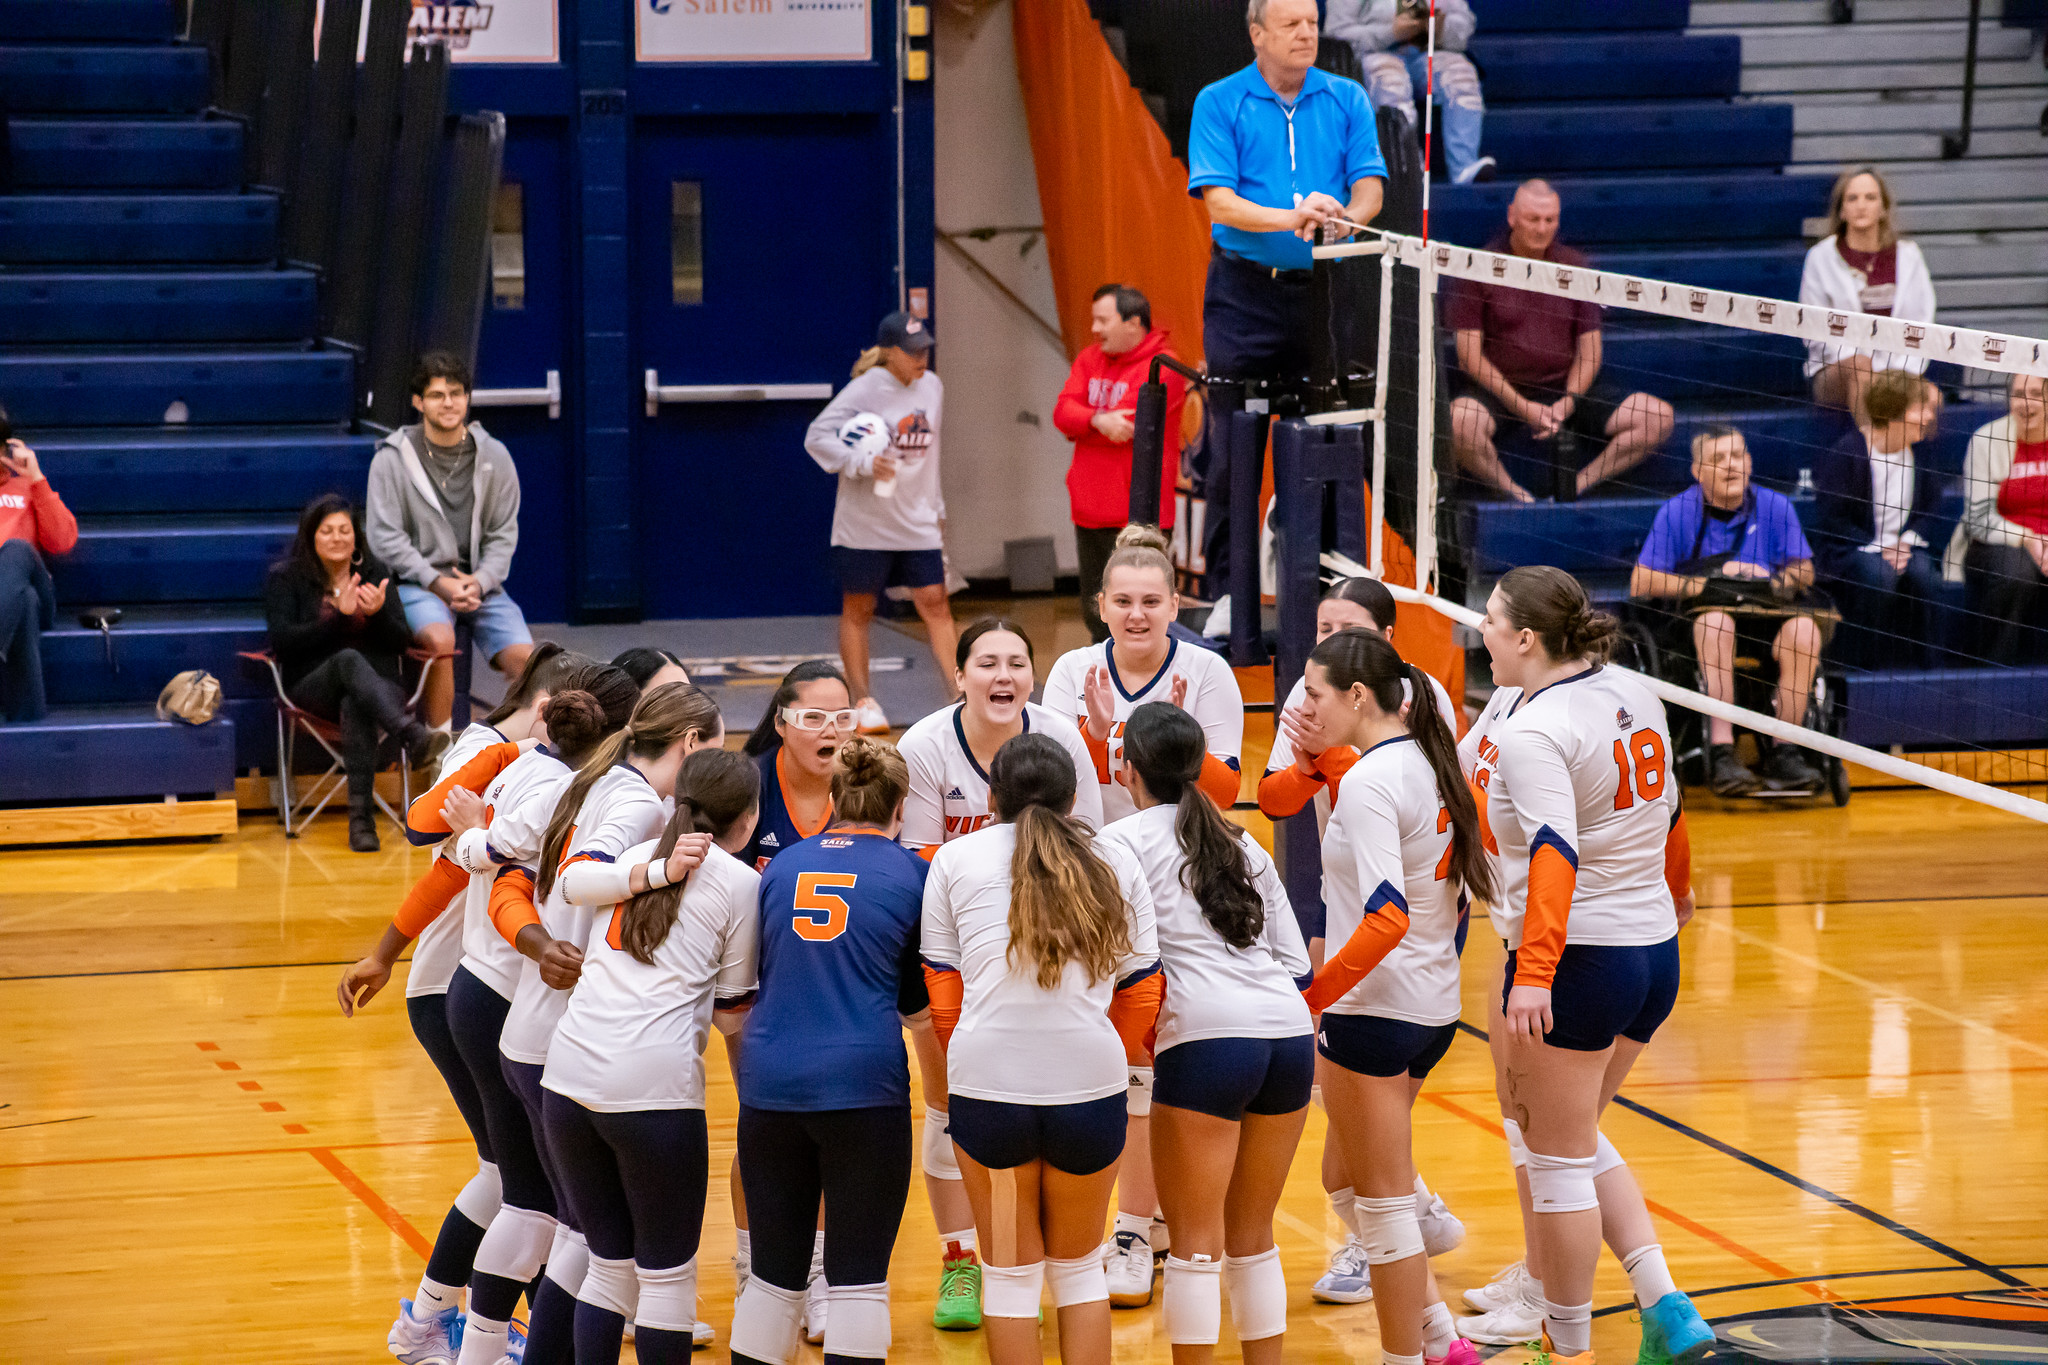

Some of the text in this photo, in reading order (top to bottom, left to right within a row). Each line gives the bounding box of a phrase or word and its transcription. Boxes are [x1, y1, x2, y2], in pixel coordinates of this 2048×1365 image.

[408, 6, 493, 30] ALEM
[1613, 727, 1665, 811] 18
[792, 871, 857, 942] 5
